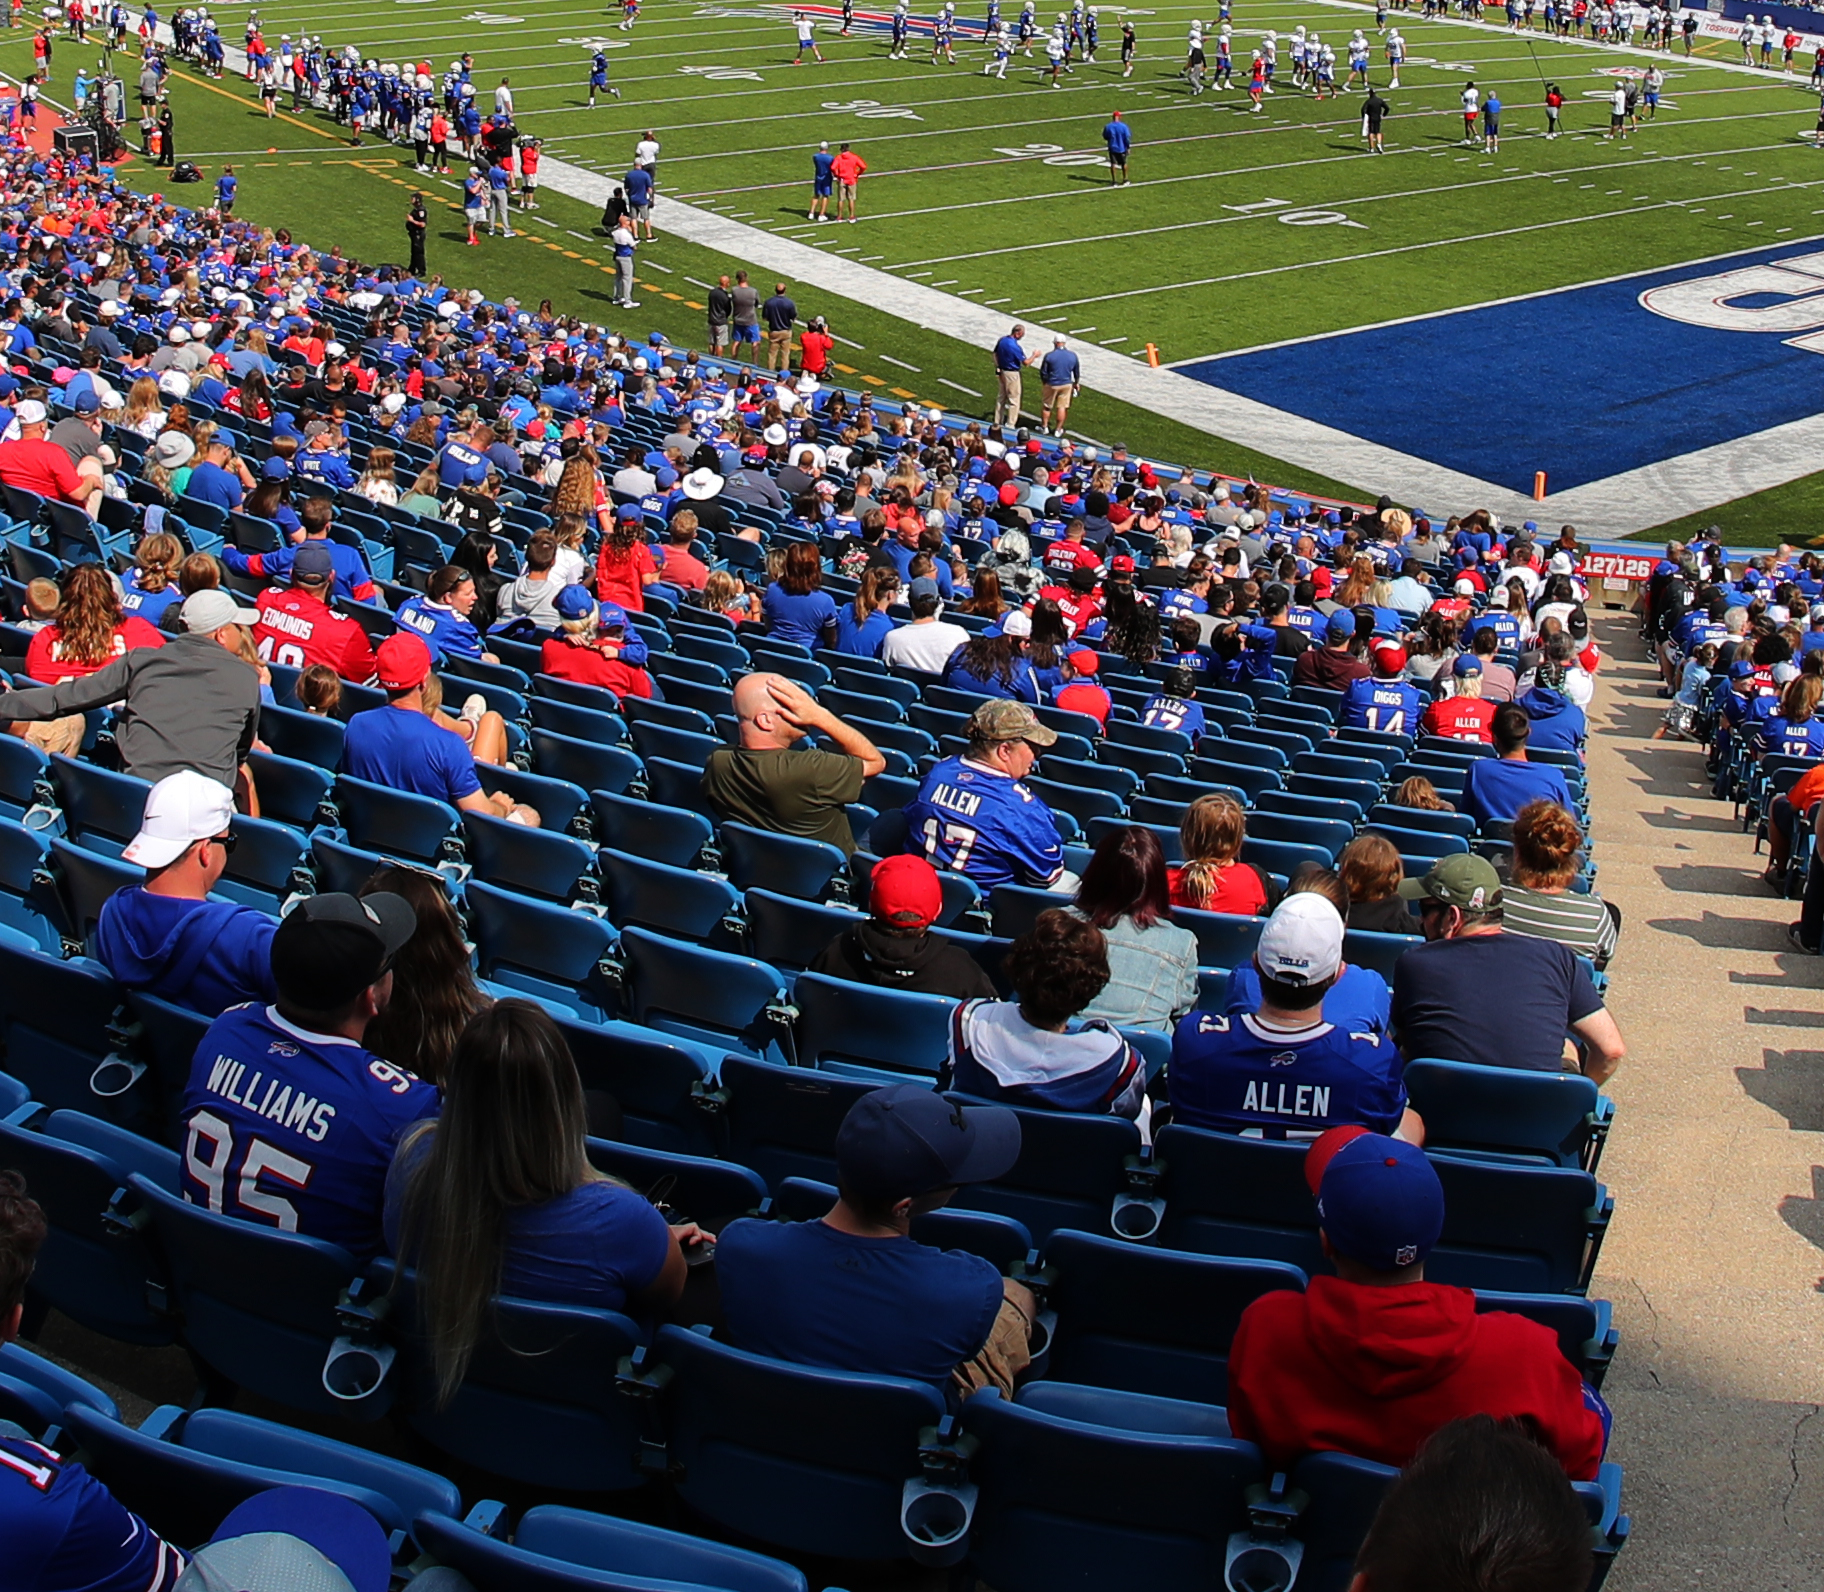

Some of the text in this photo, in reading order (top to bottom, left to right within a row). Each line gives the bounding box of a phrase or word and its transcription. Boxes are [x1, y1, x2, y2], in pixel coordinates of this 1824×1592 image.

[1705, 23, 1740, 36] TOSHIBA
[992, 143, 1108, 167] 20
[1221, 197, 1347, 227] 10
[447, 442, 481, 465] BILLS
[302, 459, 322, 471] WHITE
[641, 498, 663, 512] DIGGS
[962, 526, 982, 540] 17
[1058, 597, 1080, 616] KELLY
[261, 609, 315, 642] EDMUNDS
[400, 607, 437, 635] MILANO
[1287, 613, 1313, 626] ALLEN
[1494, 620, 1516, 632] ALLEN
[1152, 697, 1188, 718] ALLEN
[1373, 689, 1403, 705] DIGGS
[1143, 709, 1185, 730] 17
[1365, 708, 1405, 733] 14
[1454, 717, 1480, 729] ALLEN
[1785, 726, 1808, 737] ALLEN
[1782, 741, 1809, 757] 17
[929, 781, 982, 817] ALLEN
[921, 819, 976, 871] 17
[206, 1052, 339, 1143] WILLIAMS
[1240, 1080, 1332, 1119] ALLEN
[181, 1108, 316, 1232] 95
